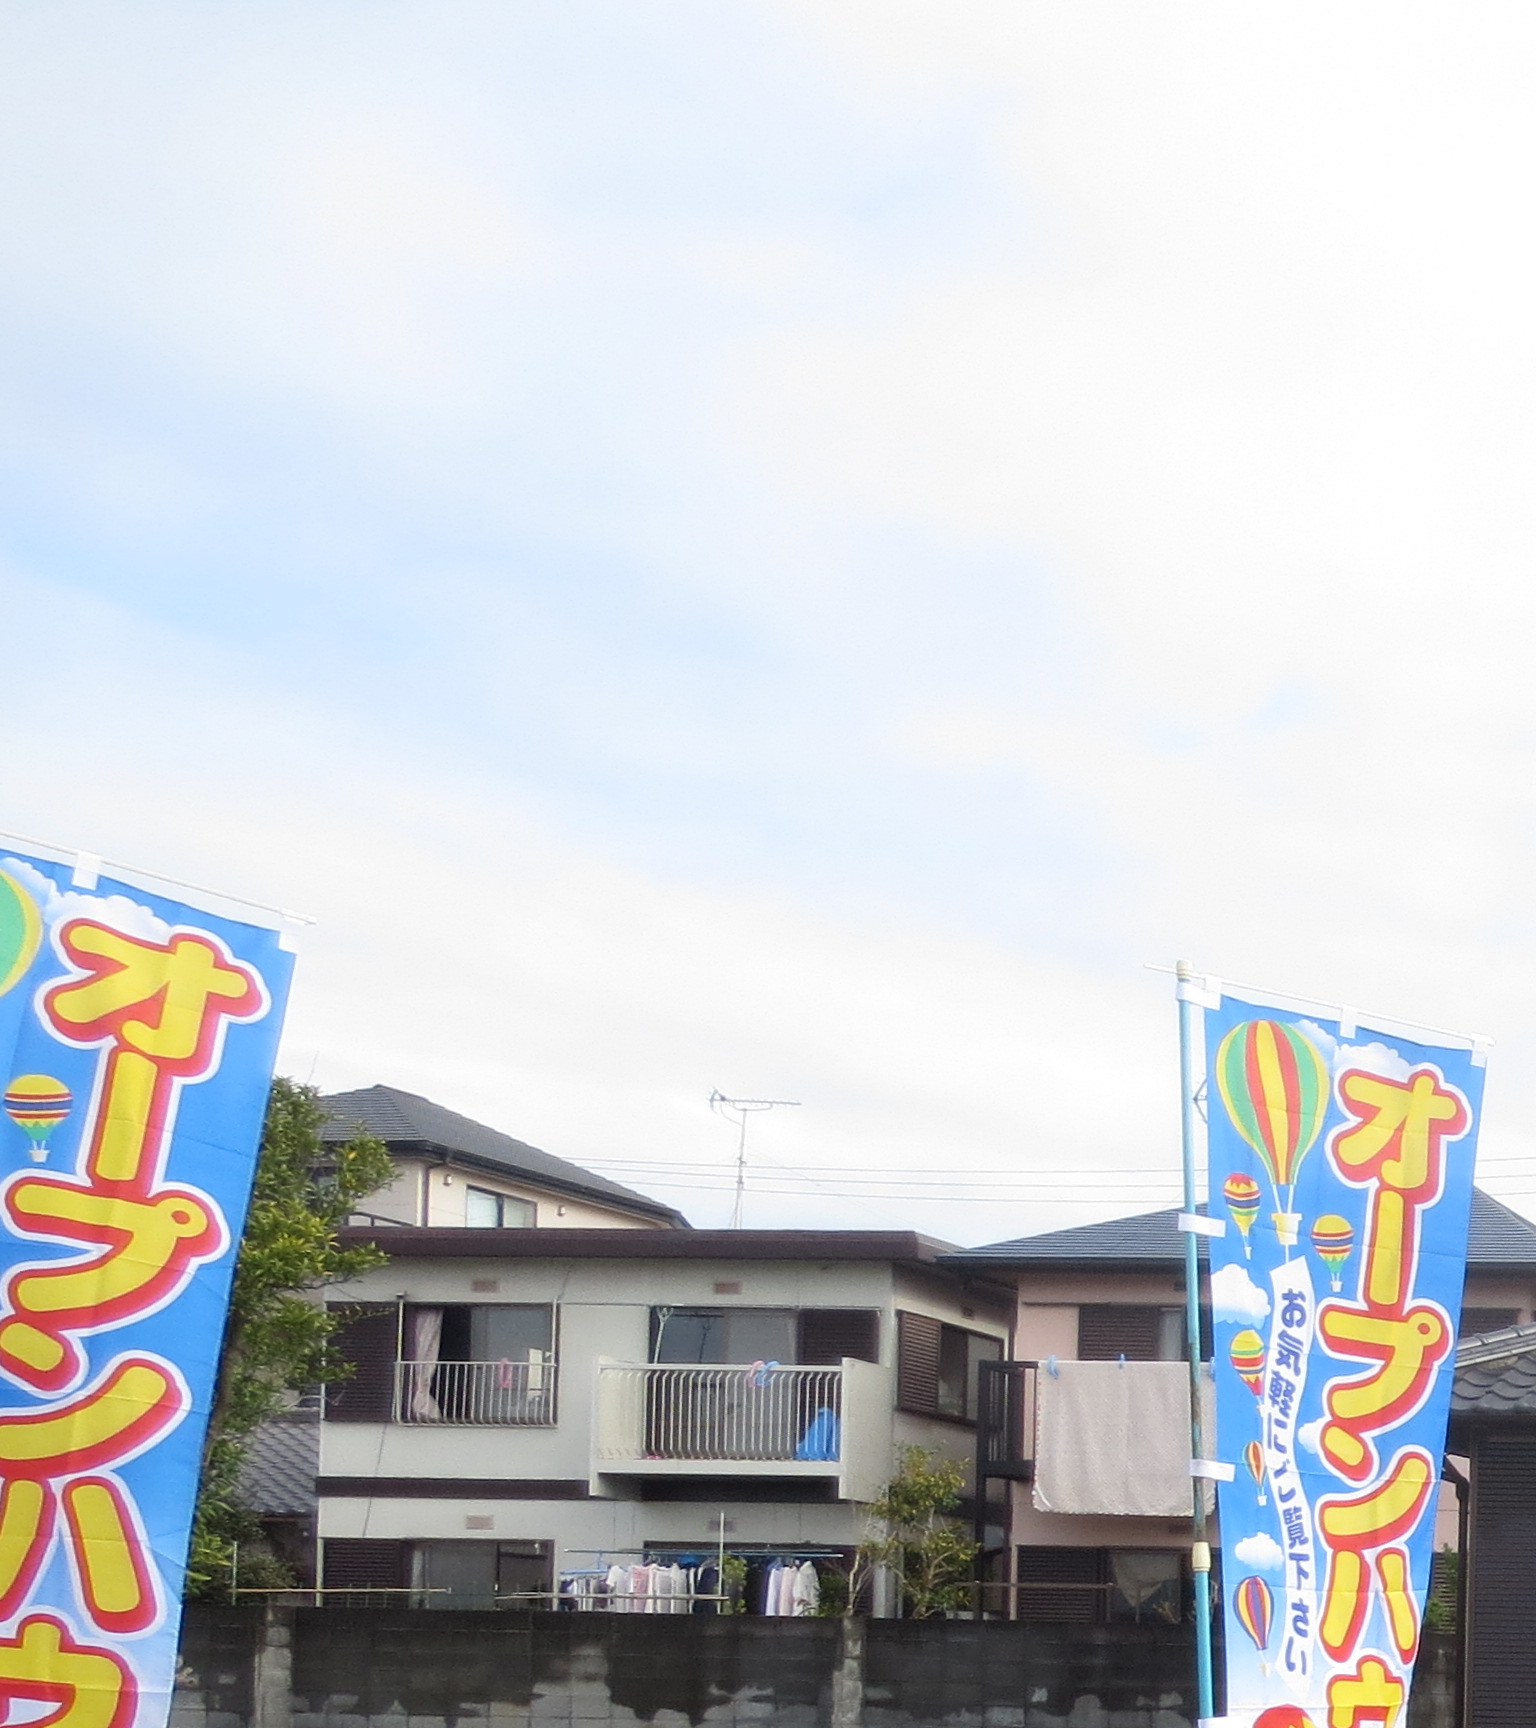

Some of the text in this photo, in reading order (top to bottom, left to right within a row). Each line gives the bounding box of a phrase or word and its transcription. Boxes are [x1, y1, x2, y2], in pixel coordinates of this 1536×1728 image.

[1266, 1287, 1310, 1677] お気軽にご覧下さい
